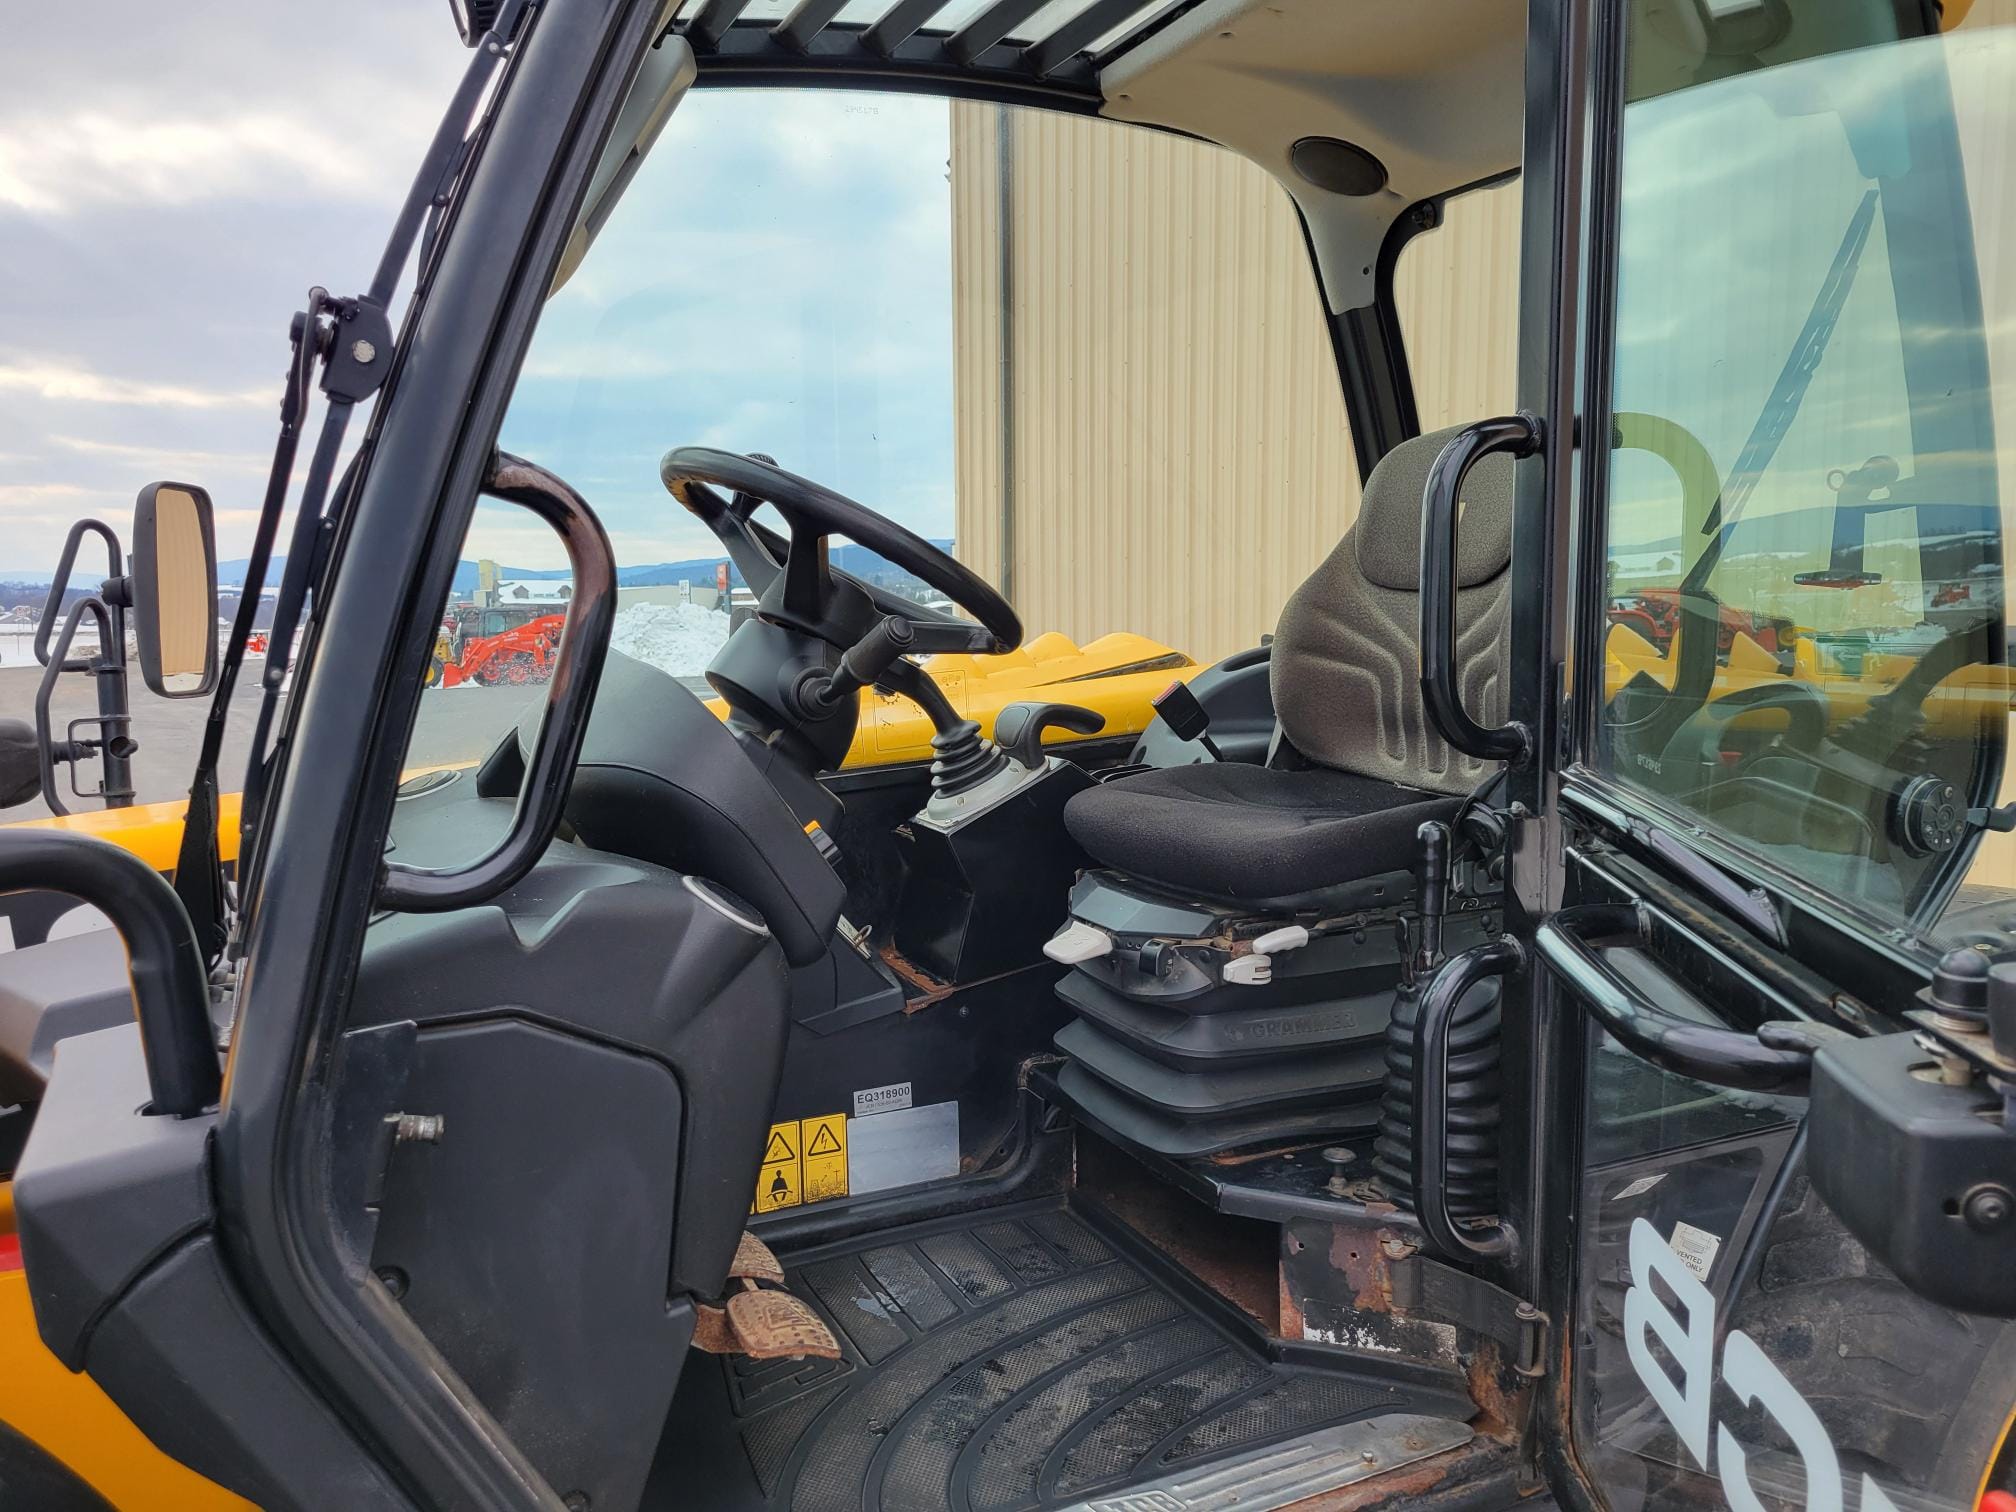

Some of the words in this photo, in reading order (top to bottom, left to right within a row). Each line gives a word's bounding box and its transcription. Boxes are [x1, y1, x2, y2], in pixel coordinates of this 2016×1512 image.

[857, 1087, 910, 1104] EQ318900
[1677, 1250, 1703, 1264] VENTED
[1685, 1261, 1704, 1273] ONLY
